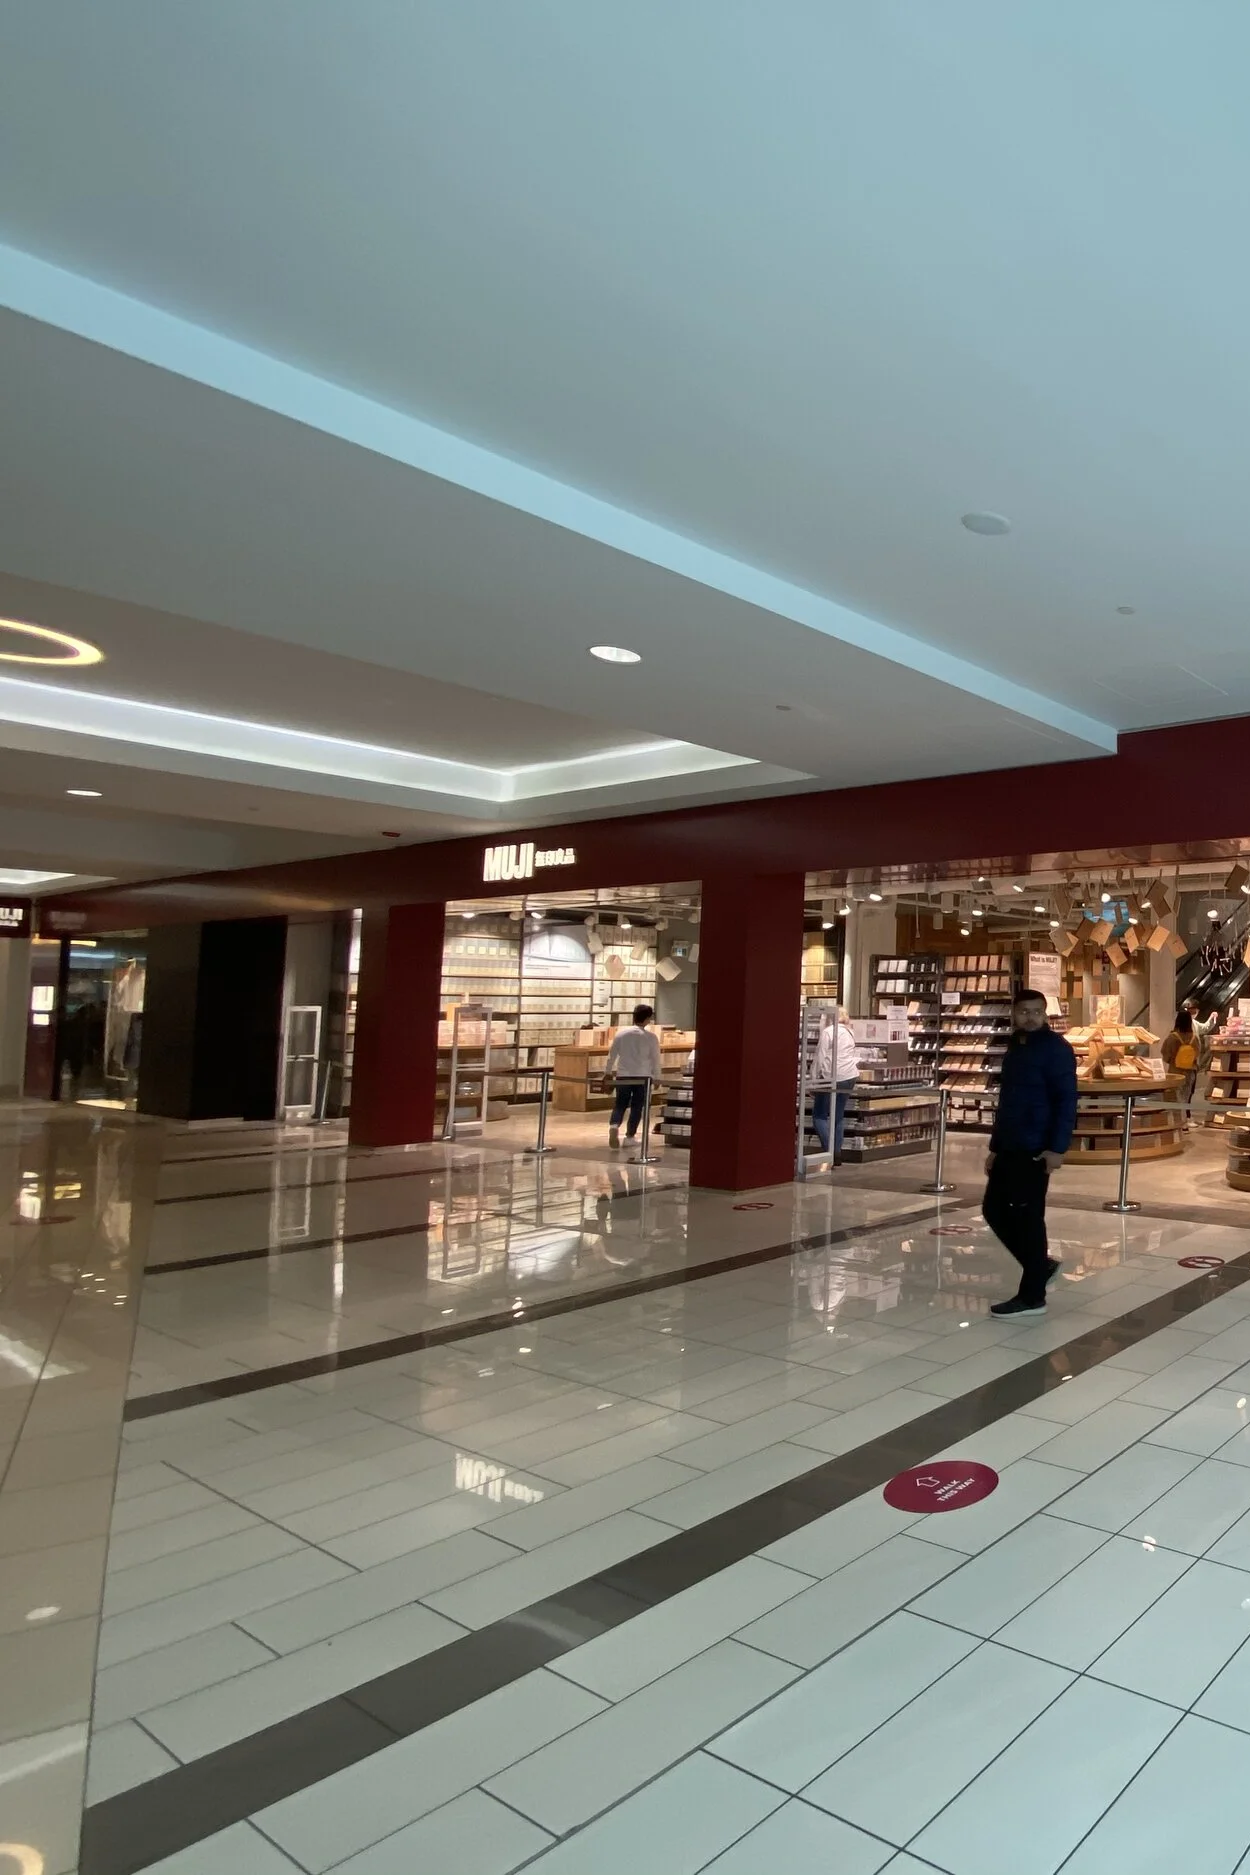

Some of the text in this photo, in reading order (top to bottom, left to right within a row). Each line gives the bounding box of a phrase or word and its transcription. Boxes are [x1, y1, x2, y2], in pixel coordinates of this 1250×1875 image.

[483, 843, 534, 881] MUJI
[0, 907, 23, 920] UJI
[933, 1480, 960, 1494] WALK
[936, 1478, 975, 1501] THIS WAY
